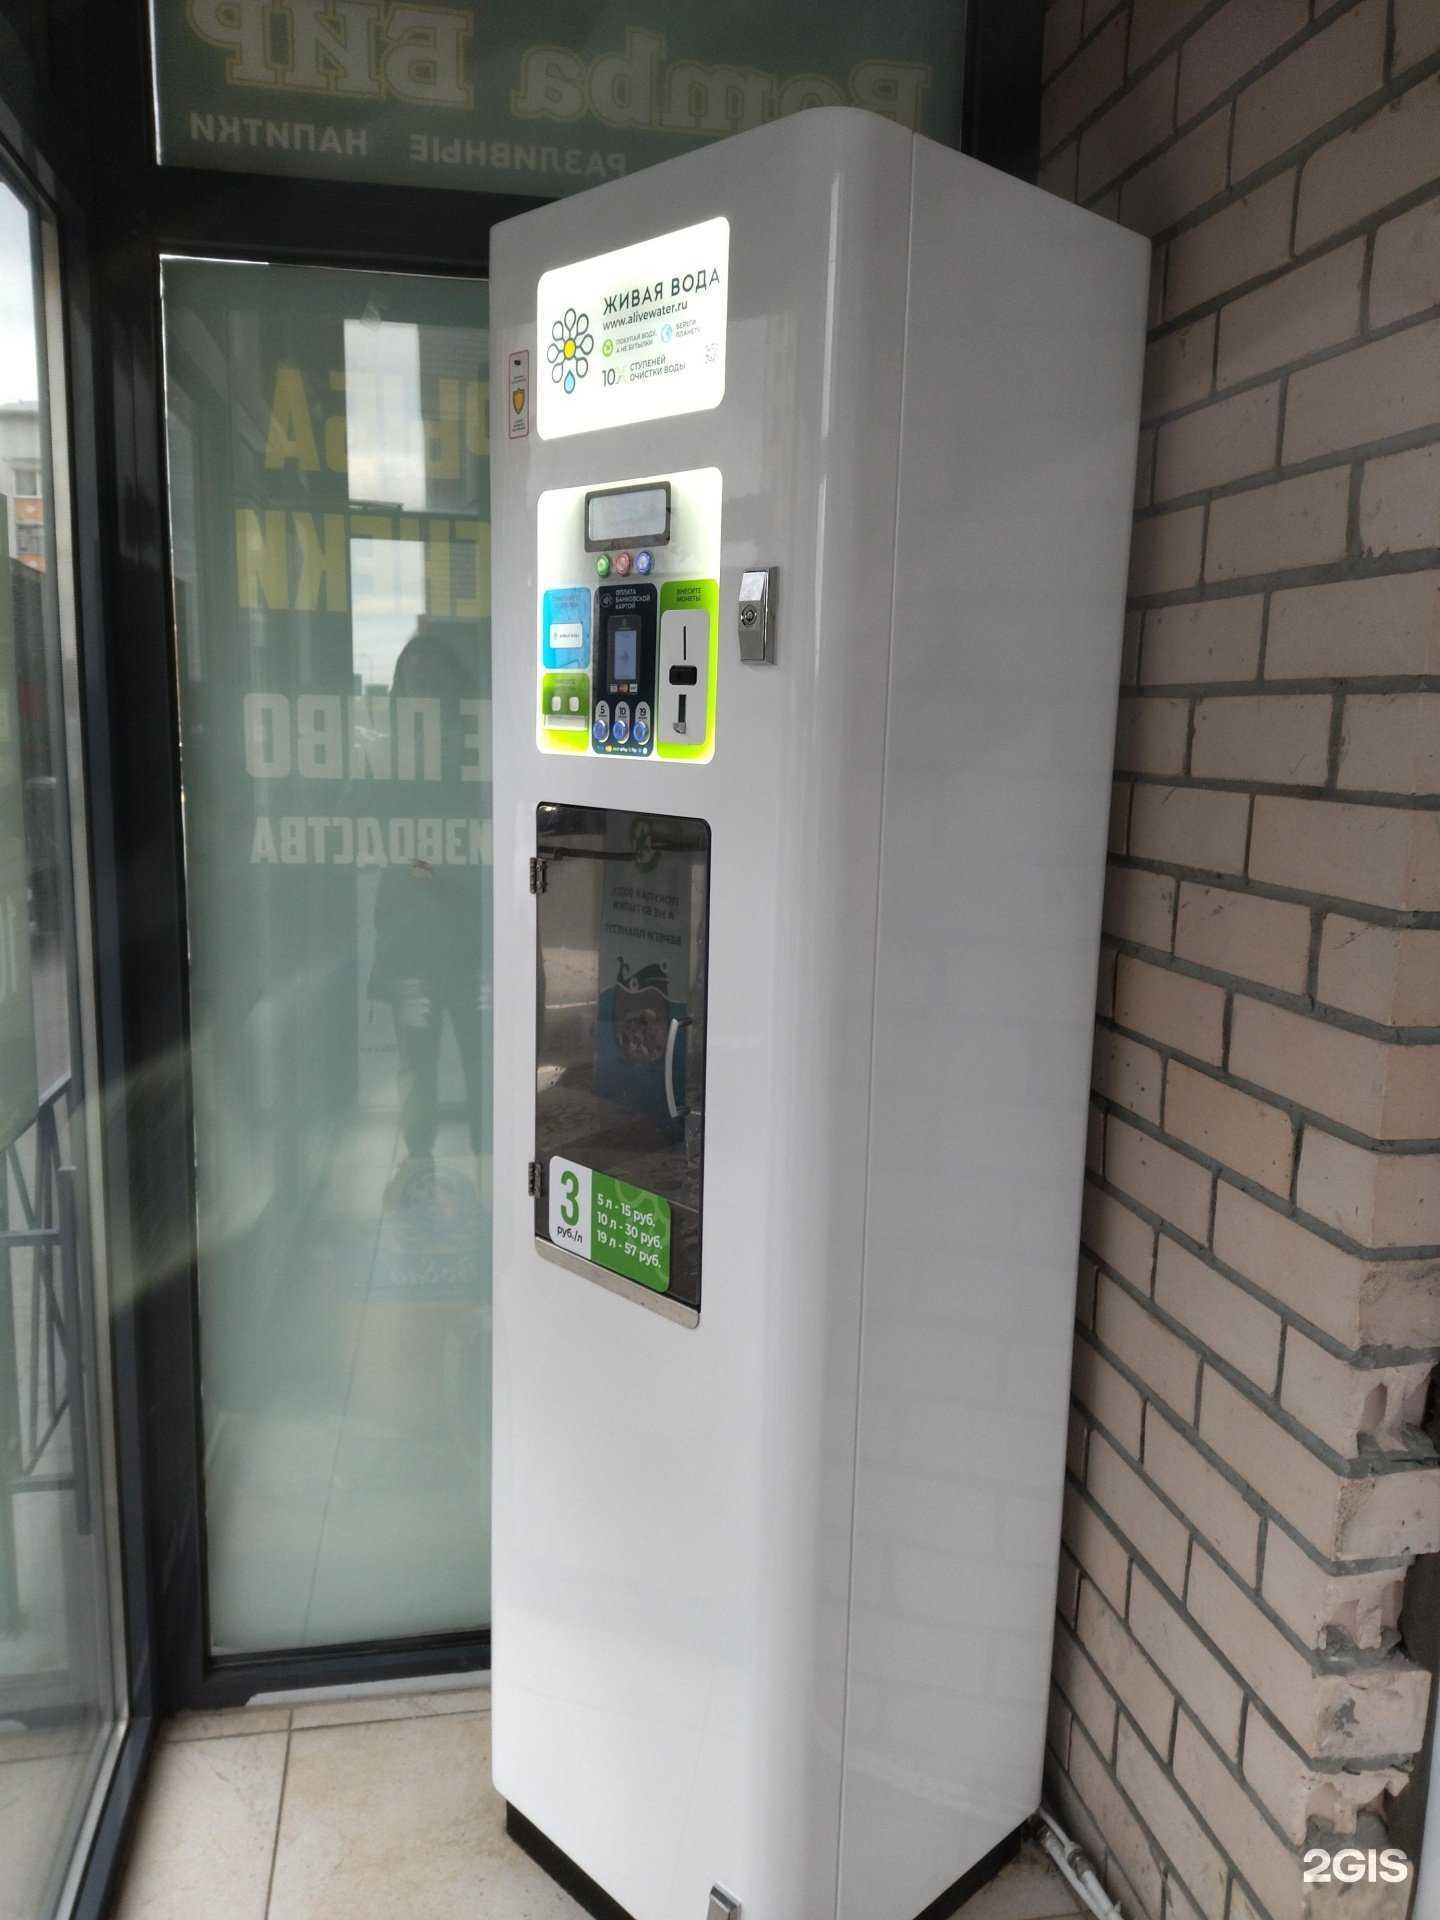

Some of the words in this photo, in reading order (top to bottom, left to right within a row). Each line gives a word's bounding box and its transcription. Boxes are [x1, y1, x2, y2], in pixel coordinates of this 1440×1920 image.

[603, 282, 664, 316] ЖИВАЯ
[671, 267, 720, 296] ВОДА
[602, 300, 688, 331] www.alivewater.ru
[602, 367, 616, 387] 10
[629, 354, 666, 371] СТУПЕНЕЙ
[629, 366, 662, 382] ОЧИСТКИ
[663, 362, 686, 374] ВОДЫ
[560, 1170, 579, 1226] 3
[597, 1193, 604, 1206] 5
[605, 1198, 612, 1209] л
[620, 1202, 631, 1217] 15
[633, 1210, 656, 1228] руб.
[556, 1225, 583, 1244] руб./л
[597, 1211, 608, 1226] 10
[610, 1217, 617, 1230] л
[625, 1223, 639, 1237] 30
[640, 1231, 663, 1249] руб.
[597, 1230, 607, 1245] 19
[609, 1236, 616, 1249] л
[624, 1243, 637, 1256] 57
[639, 1250, 662, 1268] руб.
